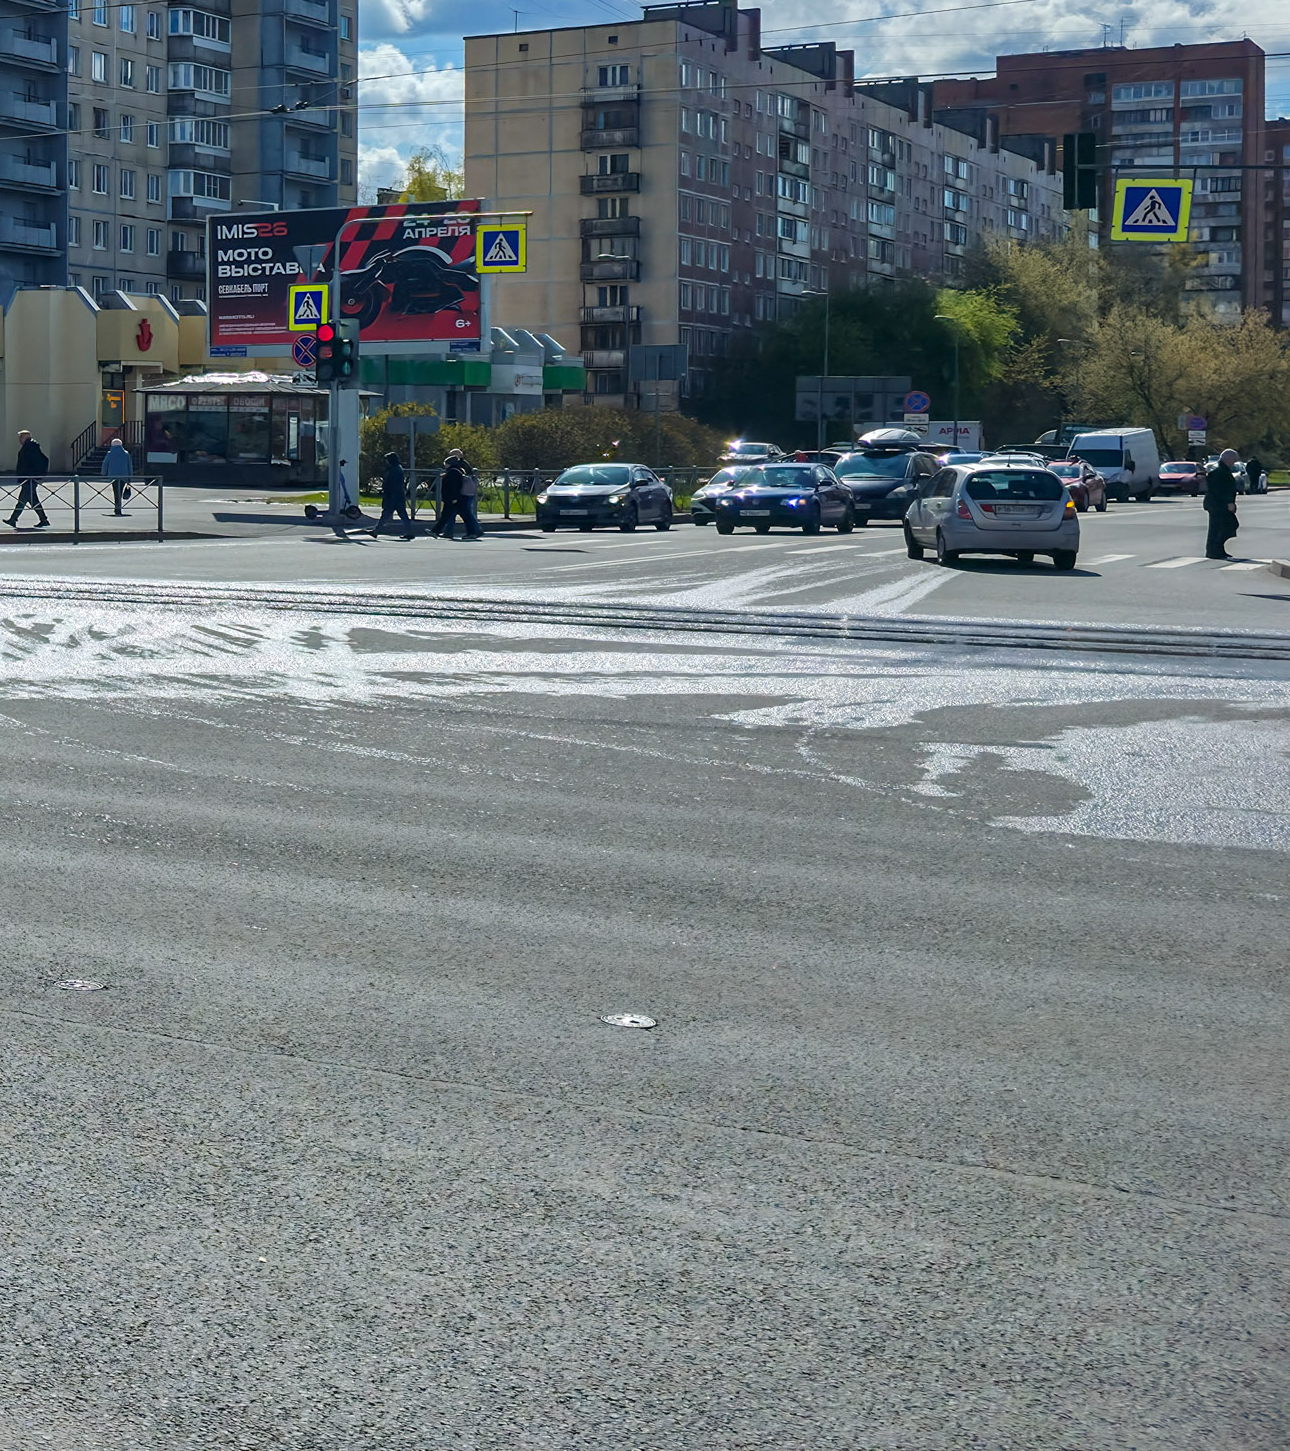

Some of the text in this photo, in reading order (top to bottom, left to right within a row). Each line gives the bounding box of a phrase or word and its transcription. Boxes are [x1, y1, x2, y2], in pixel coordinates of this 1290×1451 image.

[217, 222, 288, 240] IMIS26
[402, 225, 471, 240] АПРЕЛЯ
[217, 247, 273, 262] МОТО
[217, 262, 326, 278] ВЫСТАВА
[455, 319, 471, 329] 6+
